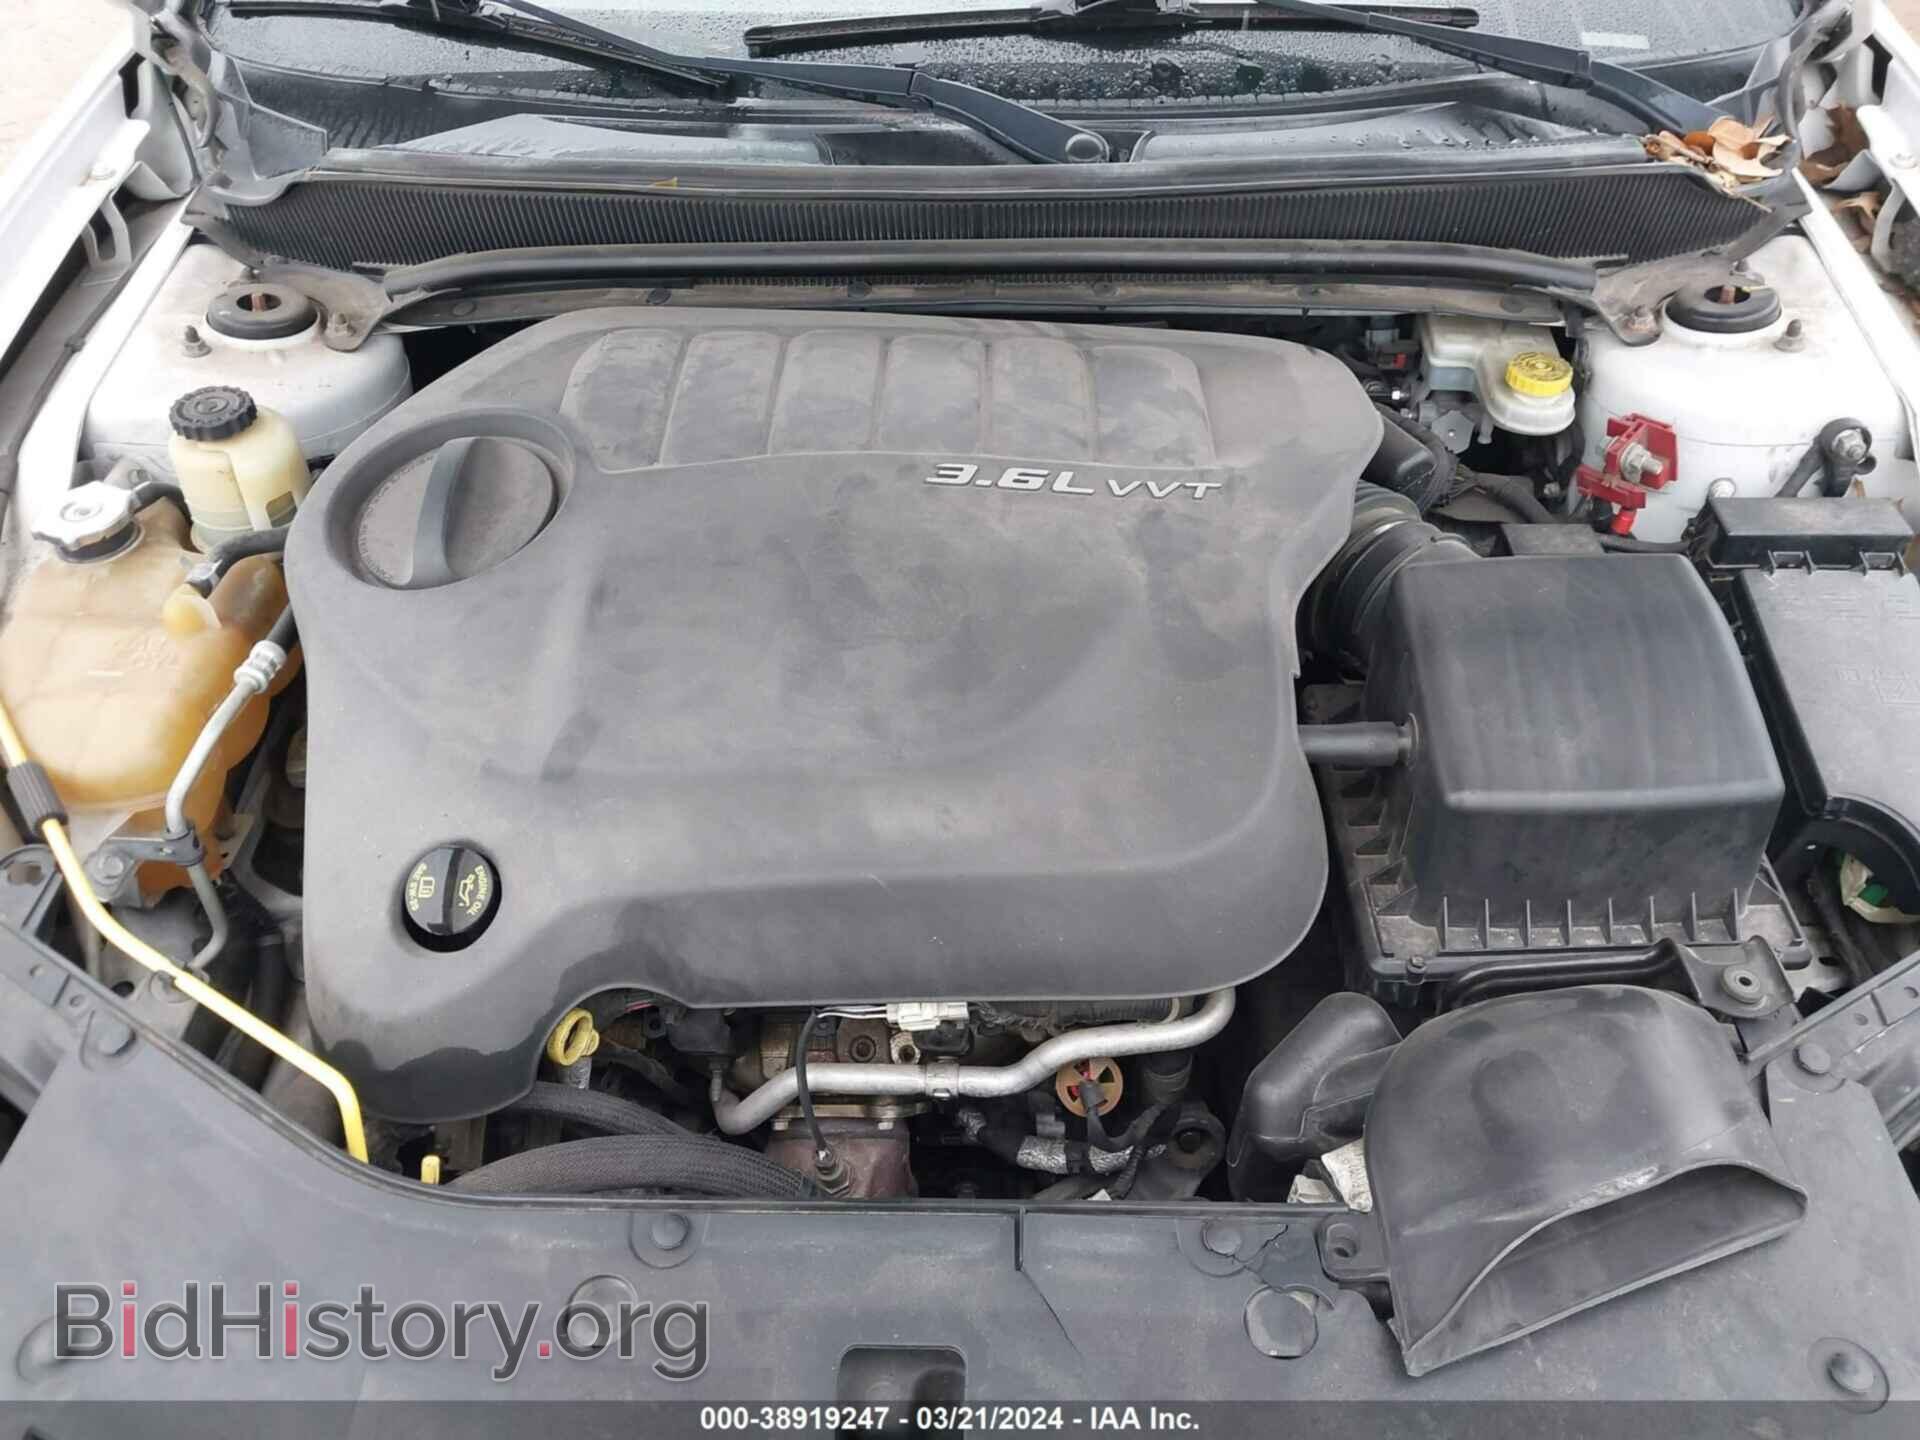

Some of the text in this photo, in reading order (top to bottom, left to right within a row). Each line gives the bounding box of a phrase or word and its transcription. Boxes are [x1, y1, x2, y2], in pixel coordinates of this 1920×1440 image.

[924, 463, 1223, 499] 3.6L VVT
[466, 864, 488, 915] ENGINE OIL
